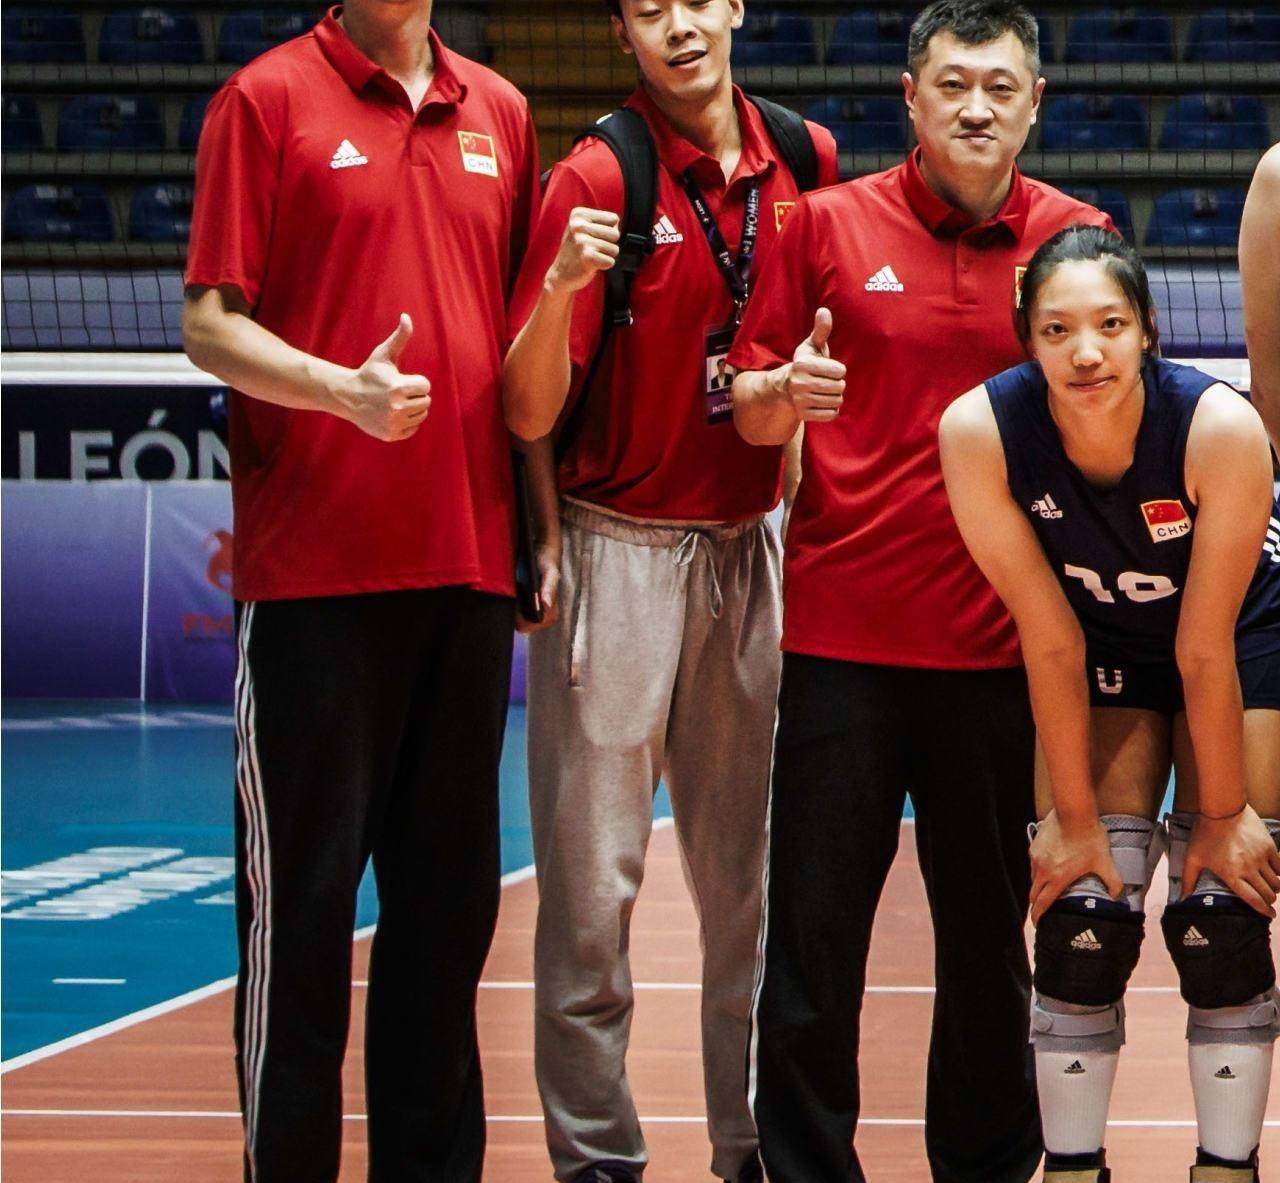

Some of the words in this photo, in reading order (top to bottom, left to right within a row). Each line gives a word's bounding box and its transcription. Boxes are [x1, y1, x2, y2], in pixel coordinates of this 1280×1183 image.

[330, 155, 368, 169] adidas
[468, 159, 494, 172] CHN
[654, 231, 684, 244] idas
[864, 281, 904, 292] adidas
[1157, 522, 1189, 538] CHN
[1071, 939, 1102, 950] adidas
[1183, 937, 1209, 947] adidas
